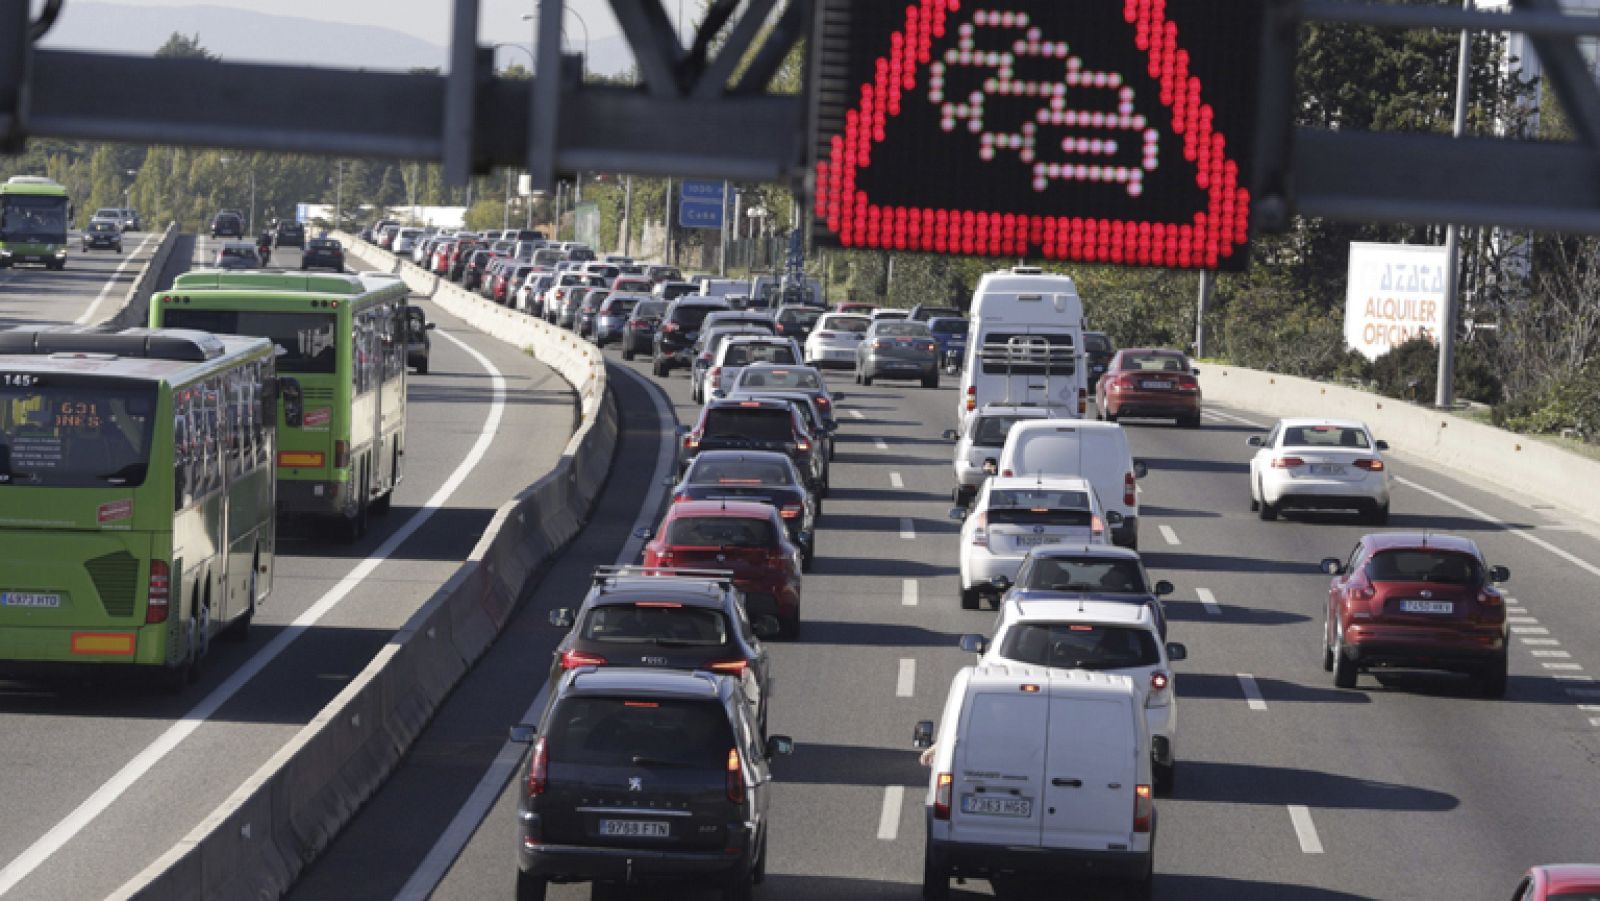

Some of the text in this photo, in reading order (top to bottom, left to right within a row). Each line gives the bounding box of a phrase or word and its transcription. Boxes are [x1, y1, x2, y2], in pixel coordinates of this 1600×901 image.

[1364, 296, 1437, 323] ALQUILER
[4, 374, 31, 387] 145
[642, 820, 667, 835] FTN
